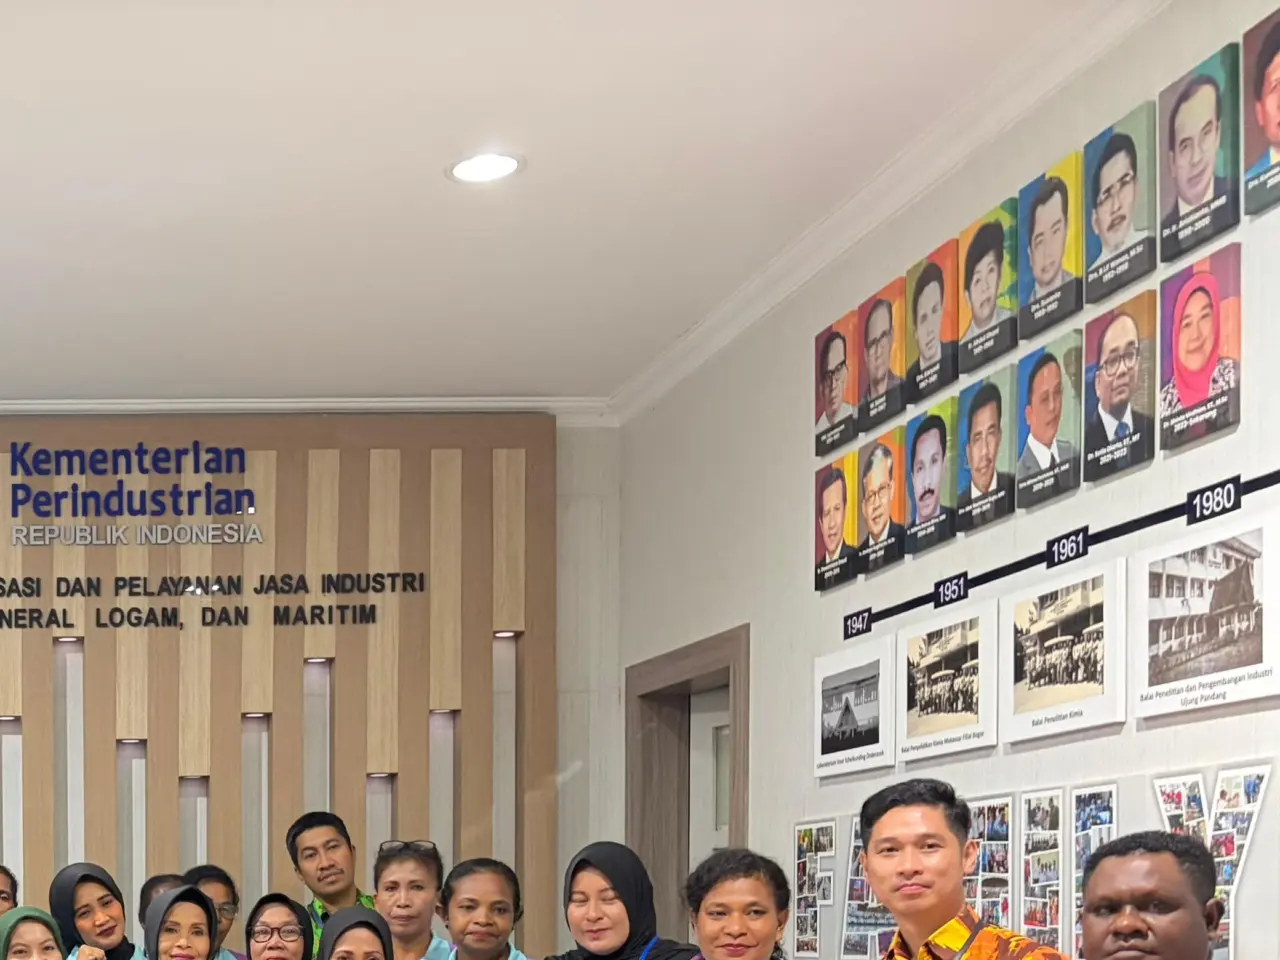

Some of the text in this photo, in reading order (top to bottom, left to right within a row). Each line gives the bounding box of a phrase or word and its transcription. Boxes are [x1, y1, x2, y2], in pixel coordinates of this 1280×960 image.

[10, 440, 246, 477] Kementerian
[11, 480, 256, 518] Perindustrian
[1193, 483, 1235, 518] 1980
[12, 523, 263, 545] REPUBLIK INDONESIA
[1052, 532, 1083, 562] 1961
[56, 576, 101, 597] DAN
[114, 575, 242, 597] PELAYANAN
[254, 574, 309, 595] JASA
[322, 572, 425, 594] INDUSTRI
[938, 577, 964, 603] 1951
[96, 606, 184, 631] LOGAM,
[202, 606, 248, 627] DAN
[274, 604, 376, 625] MARITIM
[846, 613, 869, 636] 1947
